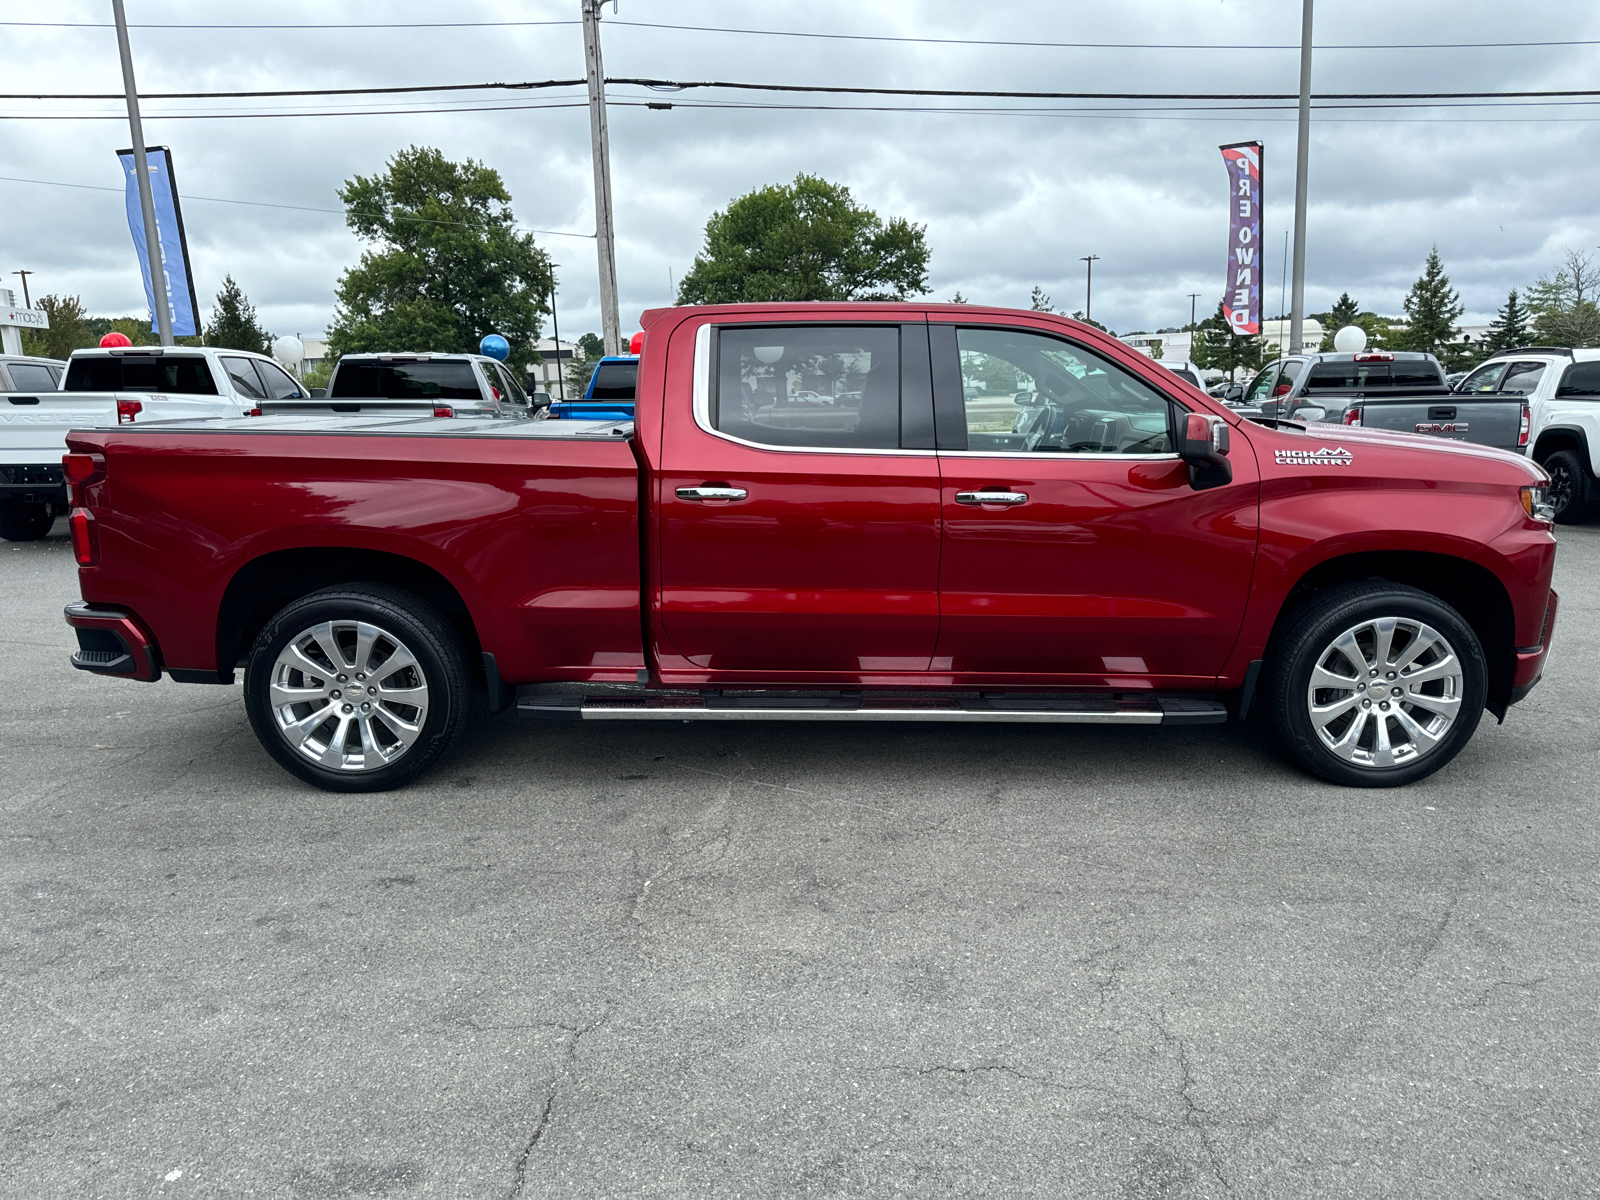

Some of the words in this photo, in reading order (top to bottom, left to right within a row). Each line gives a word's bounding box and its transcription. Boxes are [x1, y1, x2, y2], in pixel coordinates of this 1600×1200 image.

[0, 413, 104, 424] VROLET
[1415, 423, 1469, 433] GMC
[1274, 450, 1314, 458] HIGH
[1275, 457, 1353, 466] COUNTRY
